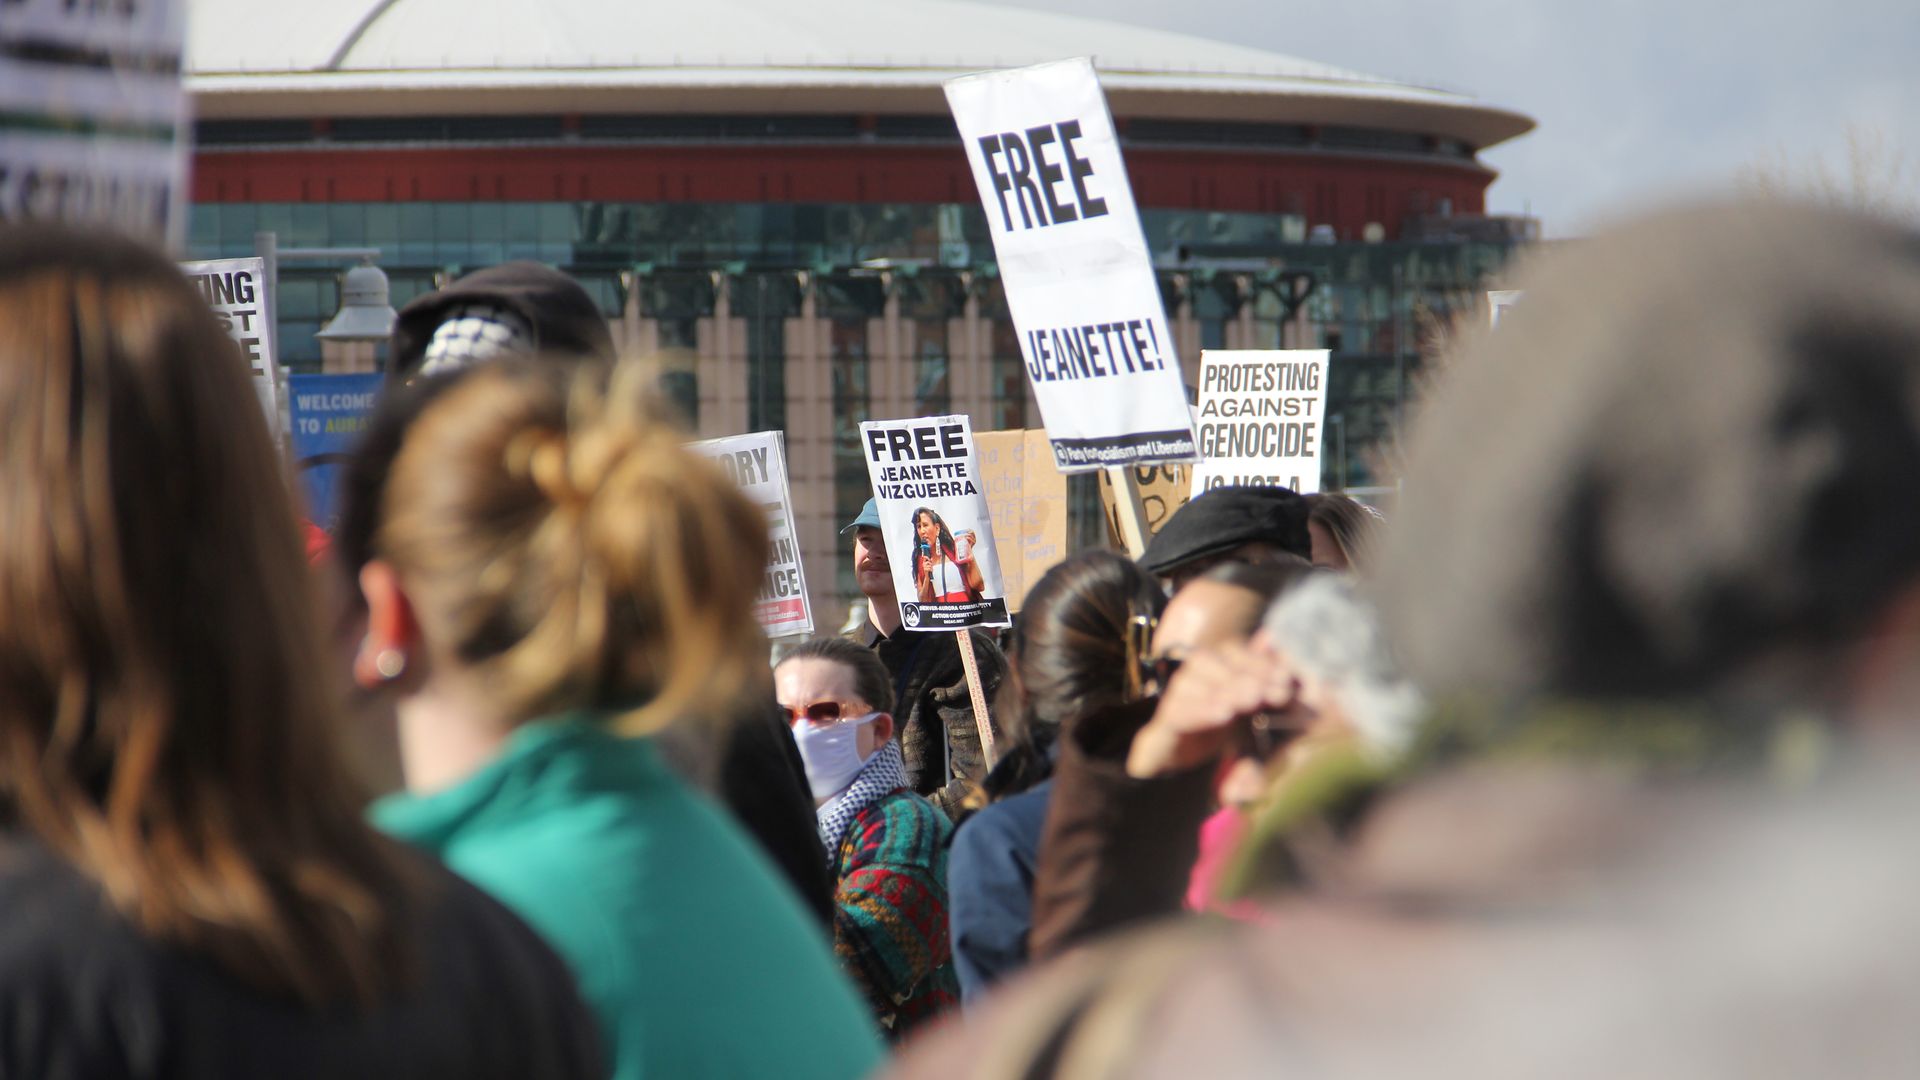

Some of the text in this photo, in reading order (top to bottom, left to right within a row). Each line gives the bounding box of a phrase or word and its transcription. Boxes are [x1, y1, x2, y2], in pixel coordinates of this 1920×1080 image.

[977, 119, 1109, 232] FREE
[1026, 318, 1165, 383] JEANETTE!
[1203, 362, 1320, 393] PROTESTING
[297, 393, 376, 411] WELCOME
[1201, 397, 1318, 418] AGAINST
[297, 417, 321, 435] TO
[867, 424, 968, 462] FREE
[1136, 443, 1151, 457] and
[1152, 440, 1193, 455] Liberation
[1199, 422, 1316, 458] GENOCIDE
[880, 462, 967, 482] JEANETTE
[877, 480, 978, 500] VIZGUERRA
[949, 610, 982, 619] COMMITTEE
